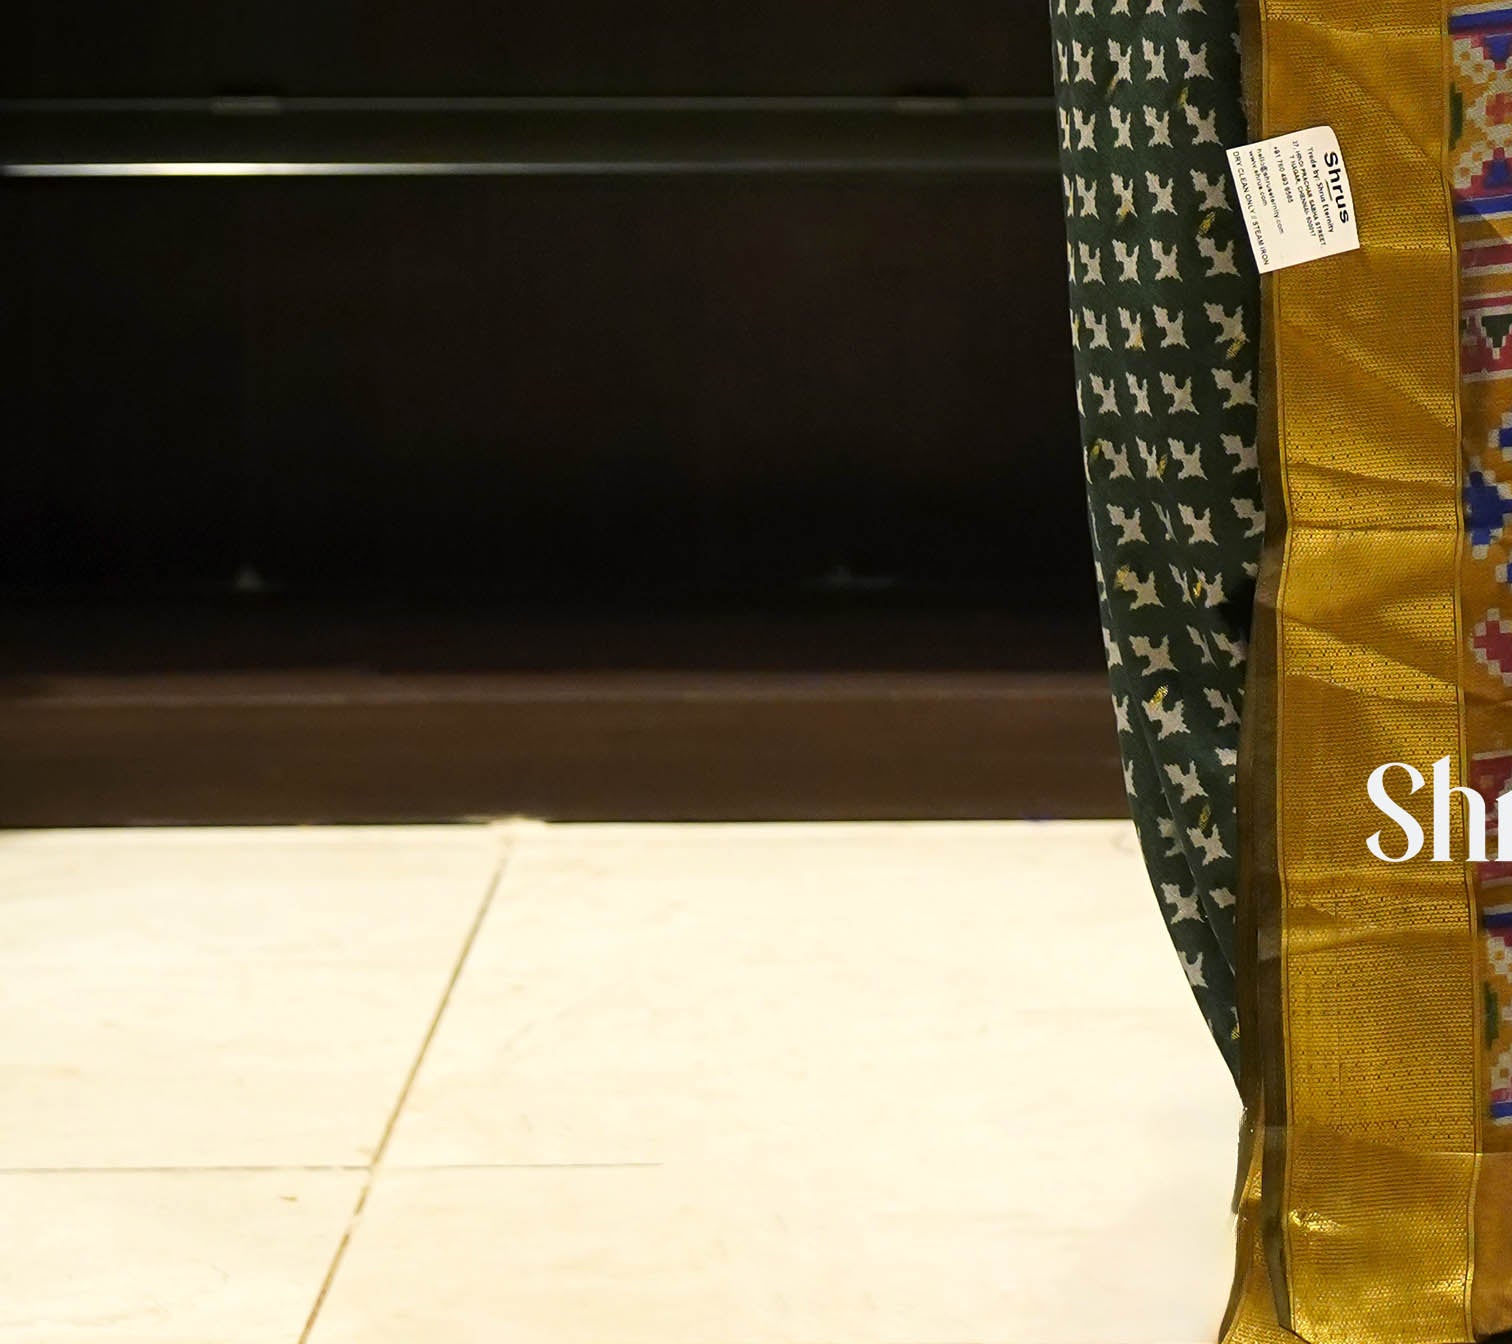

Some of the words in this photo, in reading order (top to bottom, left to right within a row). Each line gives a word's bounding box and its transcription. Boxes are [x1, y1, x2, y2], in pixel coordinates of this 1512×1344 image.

[1232, 150, 1242, 166] DRY
[1237, 167, 1249, 193] CLEAN
[1244, 193, 1256, 213] ONLY
[1251, 220, 1264, 246] STEAM
[1259, 246, 1269, 265] IRON
[1316, 181, 1326, 203] Shrus
[1321, 203, 1334, 232] Eternity
[1323, 150, 1349, 224] Shrus
